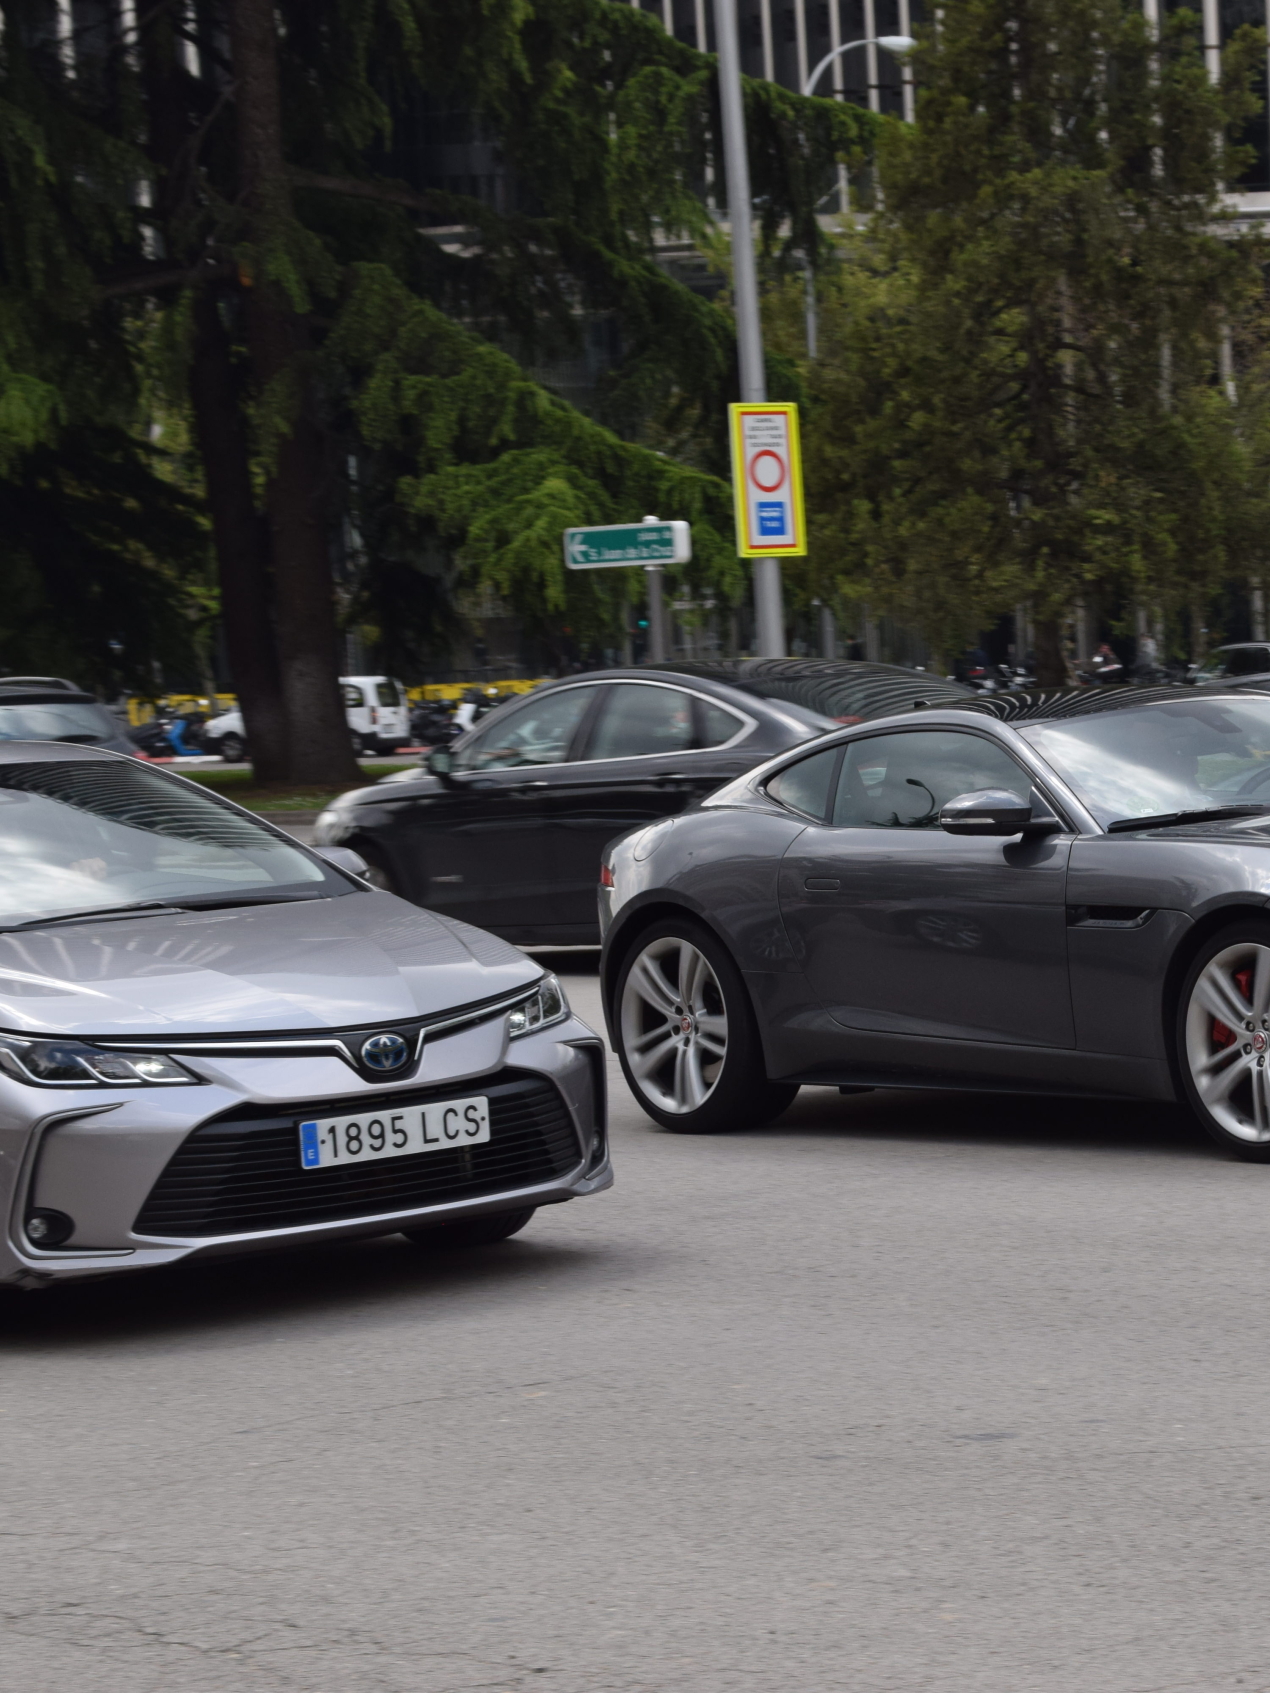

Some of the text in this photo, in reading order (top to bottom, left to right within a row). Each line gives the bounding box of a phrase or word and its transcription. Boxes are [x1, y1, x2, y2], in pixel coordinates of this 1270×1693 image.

[327, 1105, 481, 1159] 1895 LCS
[307, 1149, 315, 1160] E
